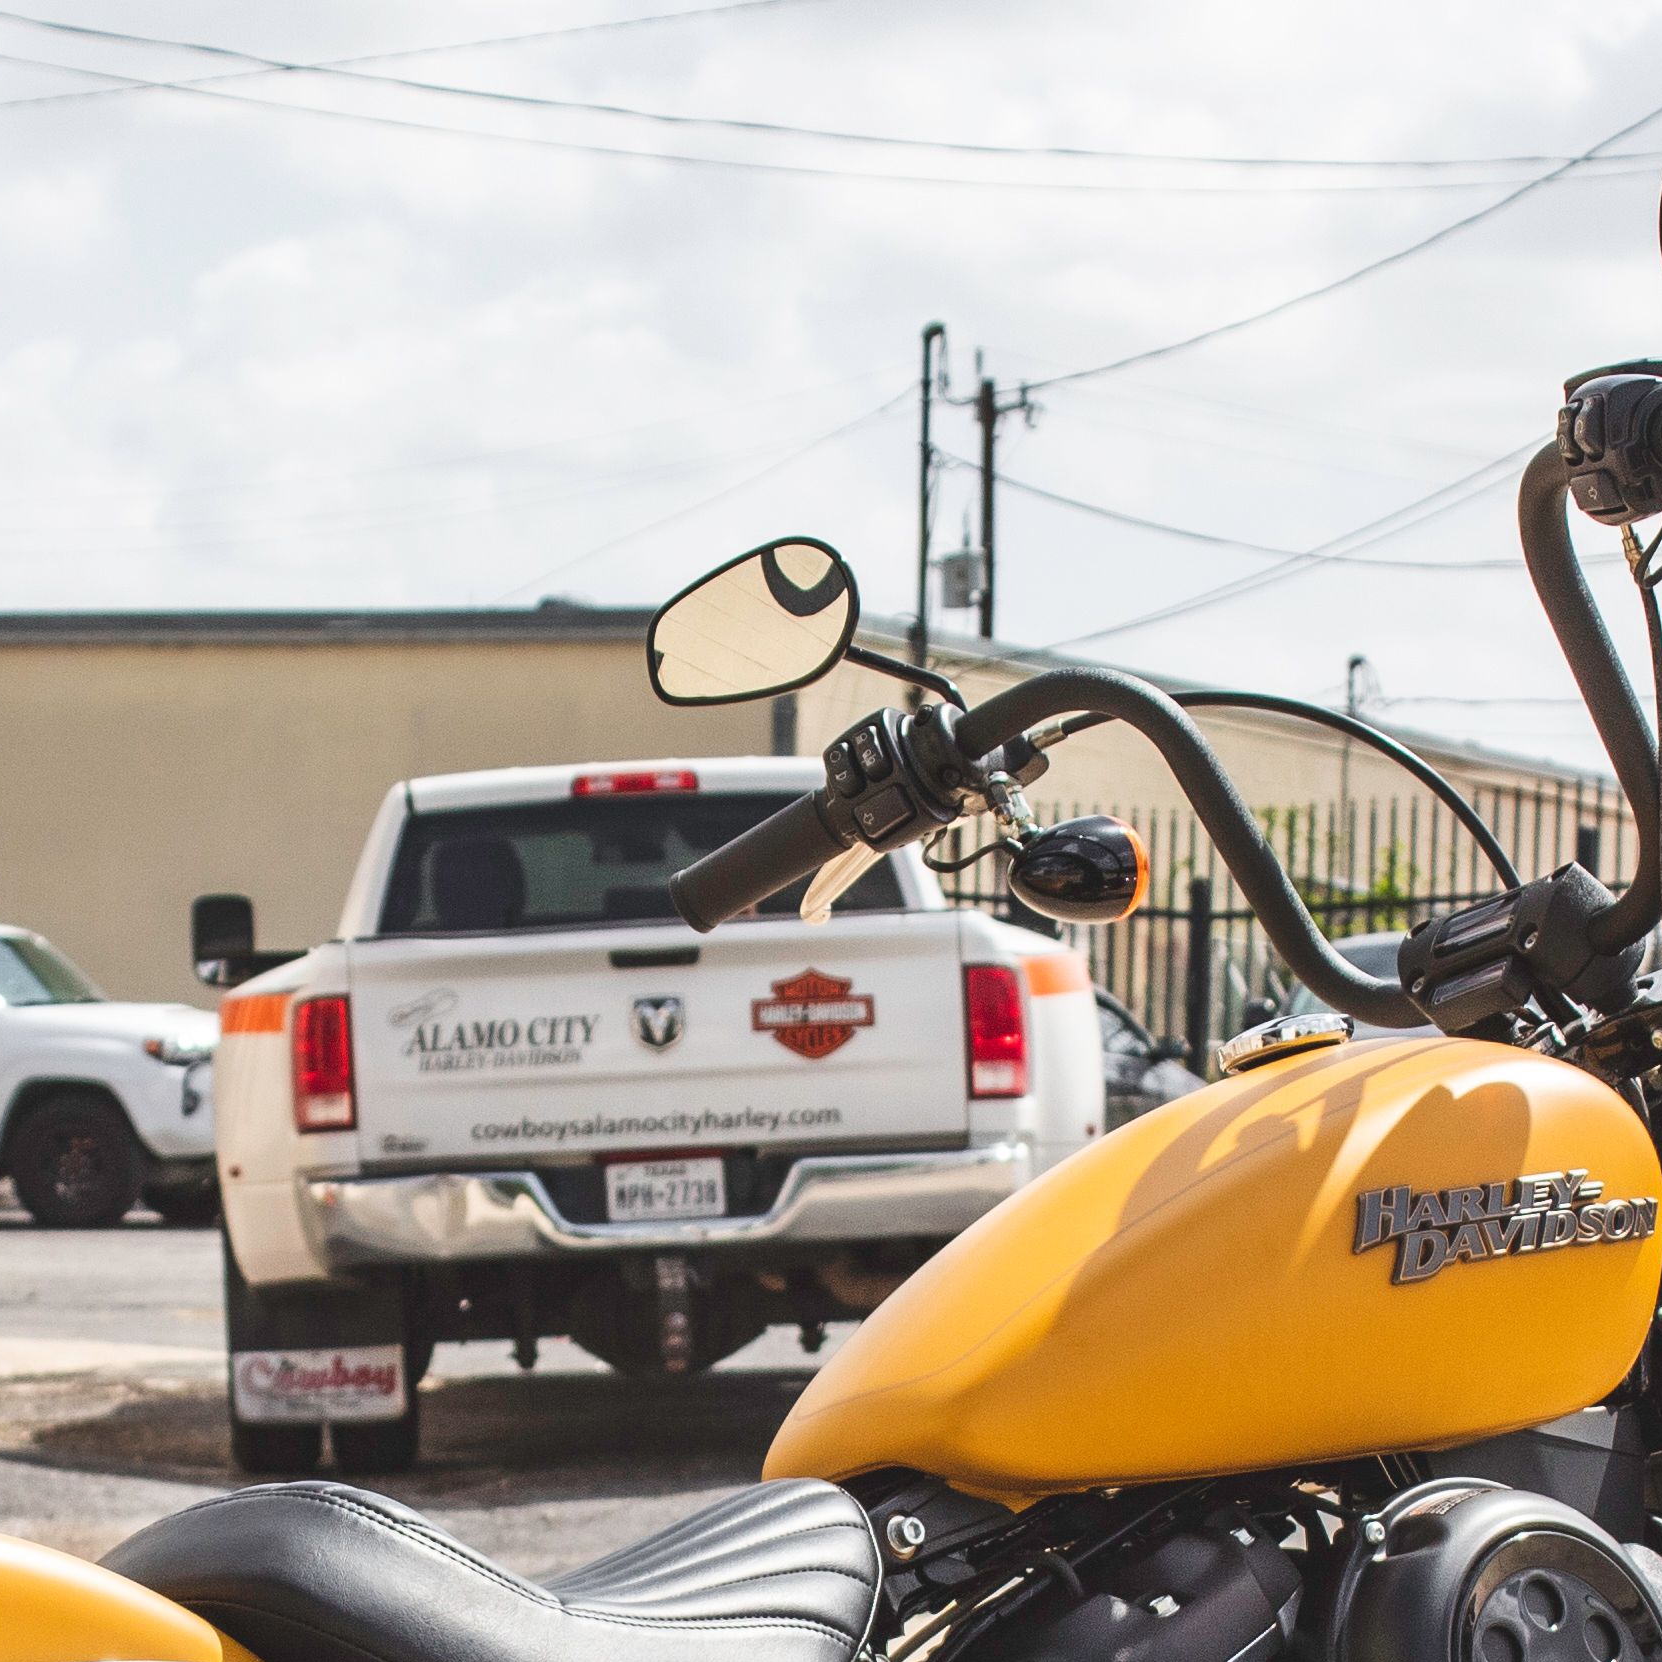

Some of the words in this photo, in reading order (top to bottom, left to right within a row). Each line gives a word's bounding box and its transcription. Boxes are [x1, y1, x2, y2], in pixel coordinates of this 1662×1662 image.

[405, 1018, 521, 1057] ALAMO
[526, 1013, 601, 1047] CITY
[469, 1104, 843, 1142] cowboysalamocityharley.com
[1391, 1196, 1659, 1285] DAVIDSON
